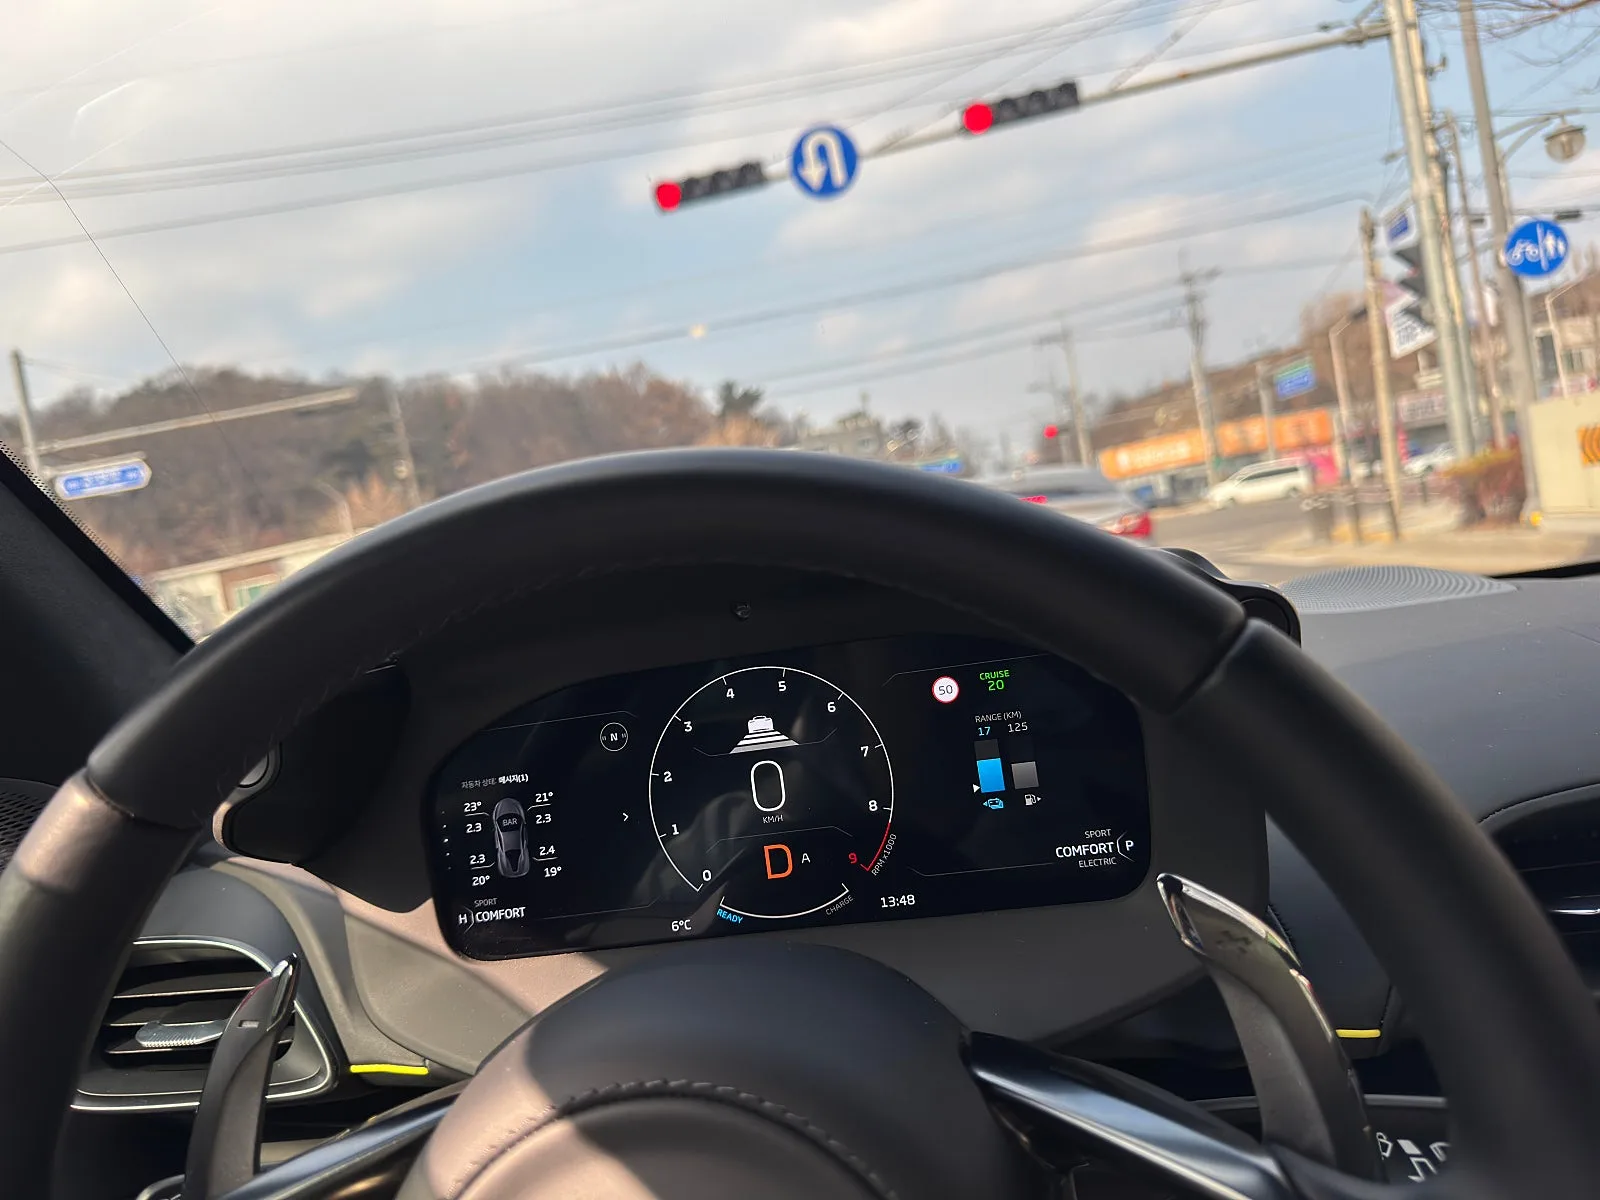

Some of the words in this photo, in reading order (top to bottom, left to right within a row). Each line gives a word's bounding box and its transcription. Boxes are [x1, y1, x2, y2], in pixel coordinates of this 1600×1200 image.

[979, 670, 1010, 680] CRUISE
[778, 681, 786, 691] 5
[938, 685, 953, 695] 50
[988, 680, 1005, 691] 20
[726, 688, 735, 699] 4
[828, 702, 836, 713] 6
[975, 713, 1002, 723] RANGE
[1003, 710, 1022, 721] (KM)
[684, 721, 693, 732] 3
[978, 727, 991, 736] 17
[1008, 722, 1028, 732] 125
[610, 733, 618, 741] N
[861, 746, 869, 757] 7
[664, 771, 672, 782] 2
[751, 760, 786, 812] 0
[869, 800, 877, 811] 8
[502, 817, 518, 826] BAR
[536, 814, 552, 824] 2.3
[762, 815, 783, 824] KM/H
[466, 823, 482, 834] 2.3
[672, 824, 679, 835] 1
[1085, 828, 1112, 838] SPORT
[539, 845, 555, 856] 2.4
[1055, 842, 1114, 857] COMFORT
[1125, 840, 1134, 851] P
[469, 854, 486, 864] 2.3
[763, 844, 793, 879] D
[801, 853, 811, 864] A
[848, 853, 857, 864] 9
[1078, 857, 1117, 868] ELECTRIC
[871, 859, 885, 876] RPM
[702, 870, 711, 880] 0
[474, 898, 497, 907] SPORT
[825, 895, 854, 916] CHARGE
[881, 895, 915, 907] 13:48
[458, 914, 468, 925] H
[475, 907, 526, 922] COMFORT
[717, 908, 743, 924] READY
